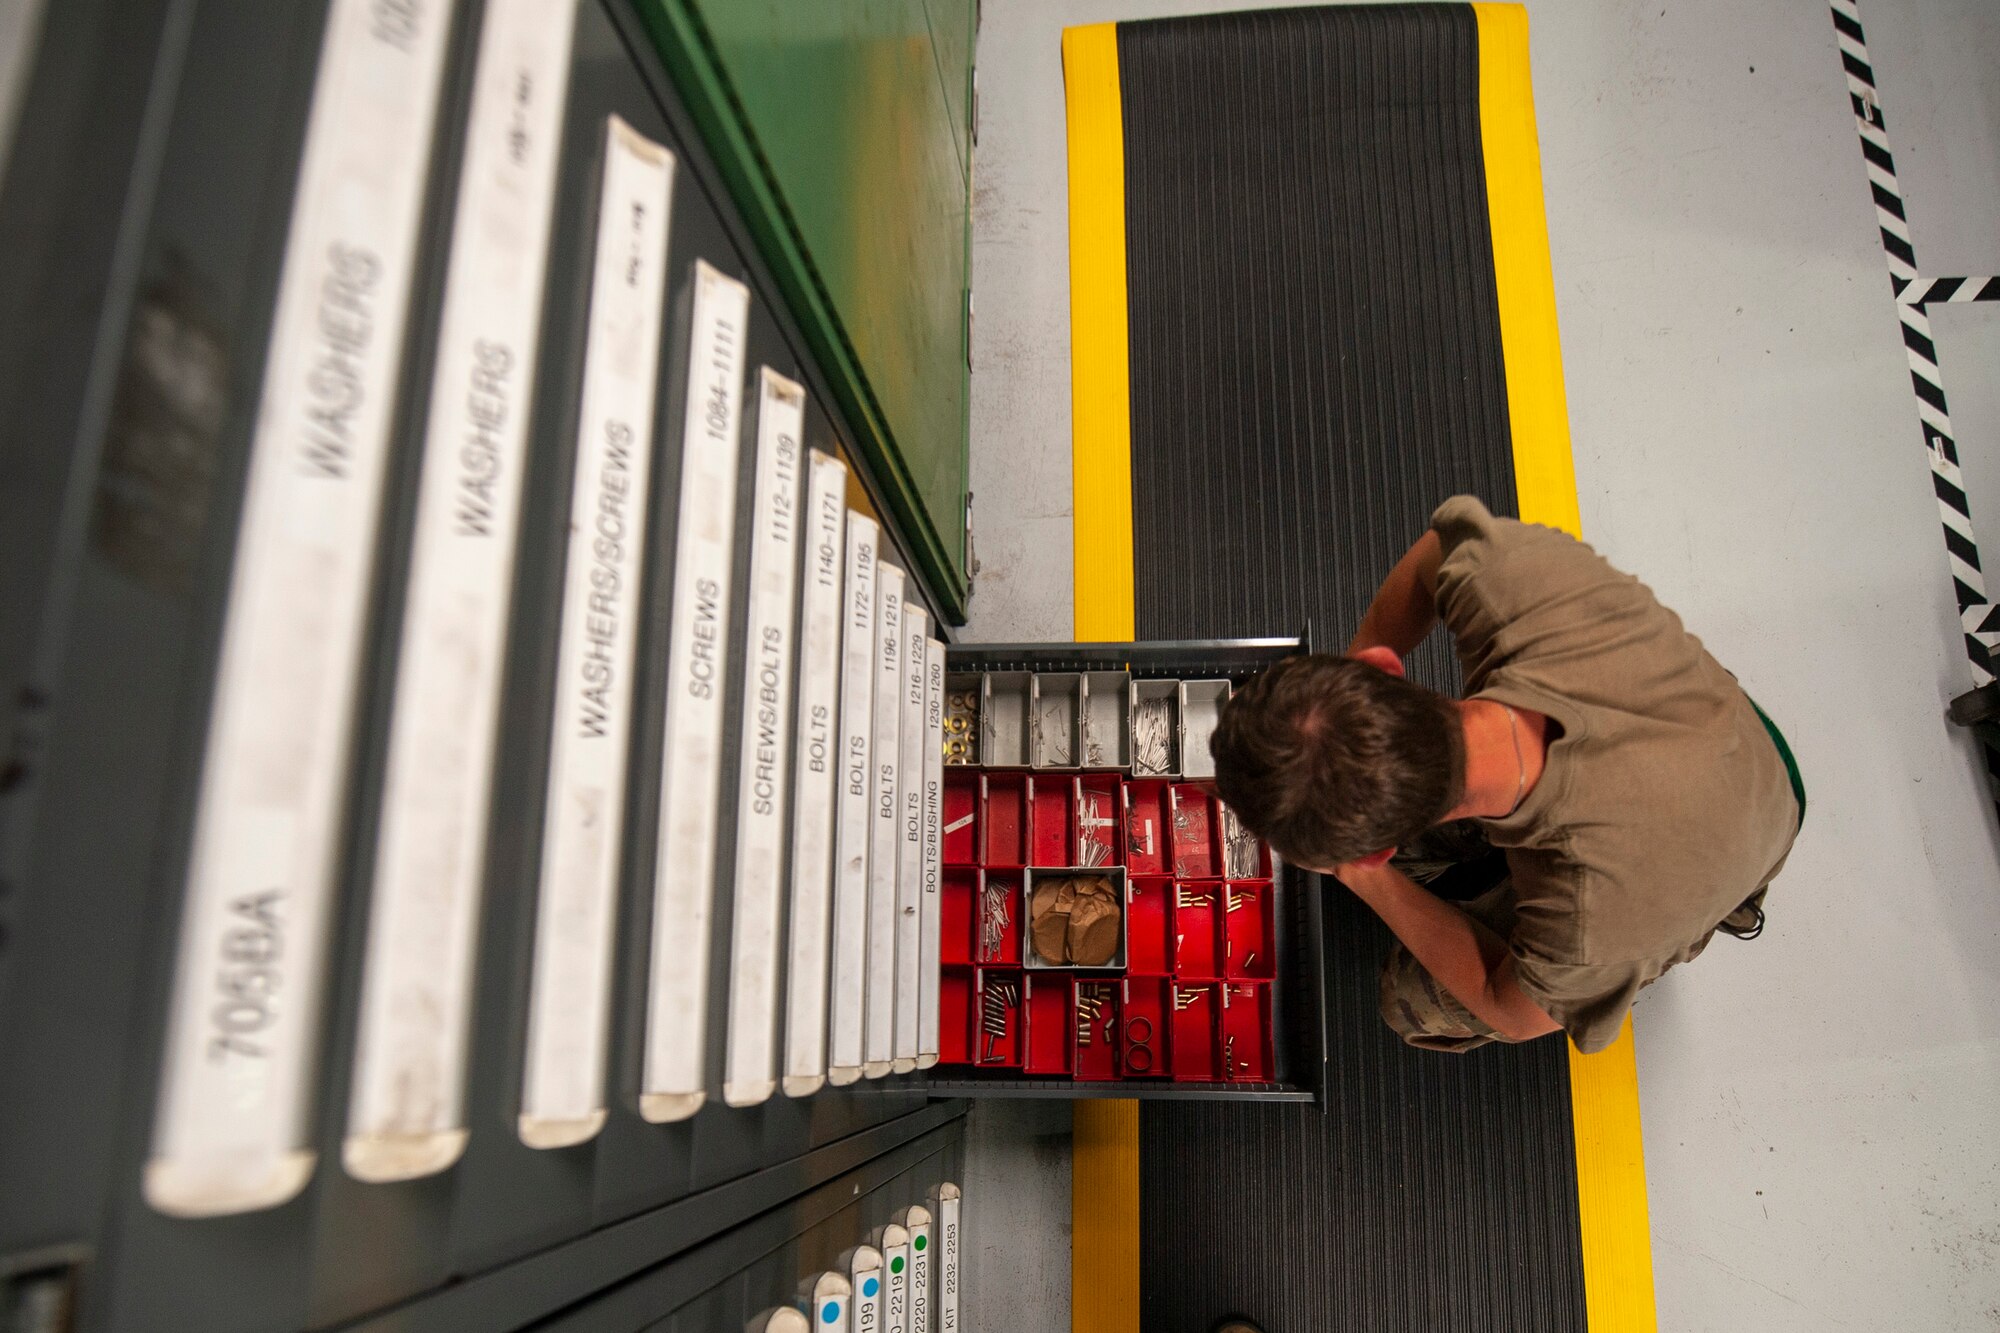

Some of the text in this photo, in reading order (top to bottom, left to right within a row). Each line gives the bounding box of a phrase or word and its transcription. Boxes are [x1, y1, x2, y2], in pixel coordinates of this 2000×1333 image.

[296, 239, 385, 482] WASHERS
[453, 337, 516, 539] WASHERS
[579, 418, 634, 739] WASHERS/SCREWS
[688, 318, 735, 700] SCREWS 1084-1111
[753, 432, 796, 816] SCREWS/BOLTS 1112-1139
[809, 491, 839, 773] BOLTS 1140-1171
[850, 543, 872, 796] BOLTS 1172-1195
[881, 593, 897, 819] BOLTS 1196-1215
[907, 634, 922, 842] BOLTS 1216-1229
[926, 663, 941, 893] BOLTS/BUSHING 1230-1260
[945, 1223, 956, 1329] KIT 2232-2253
